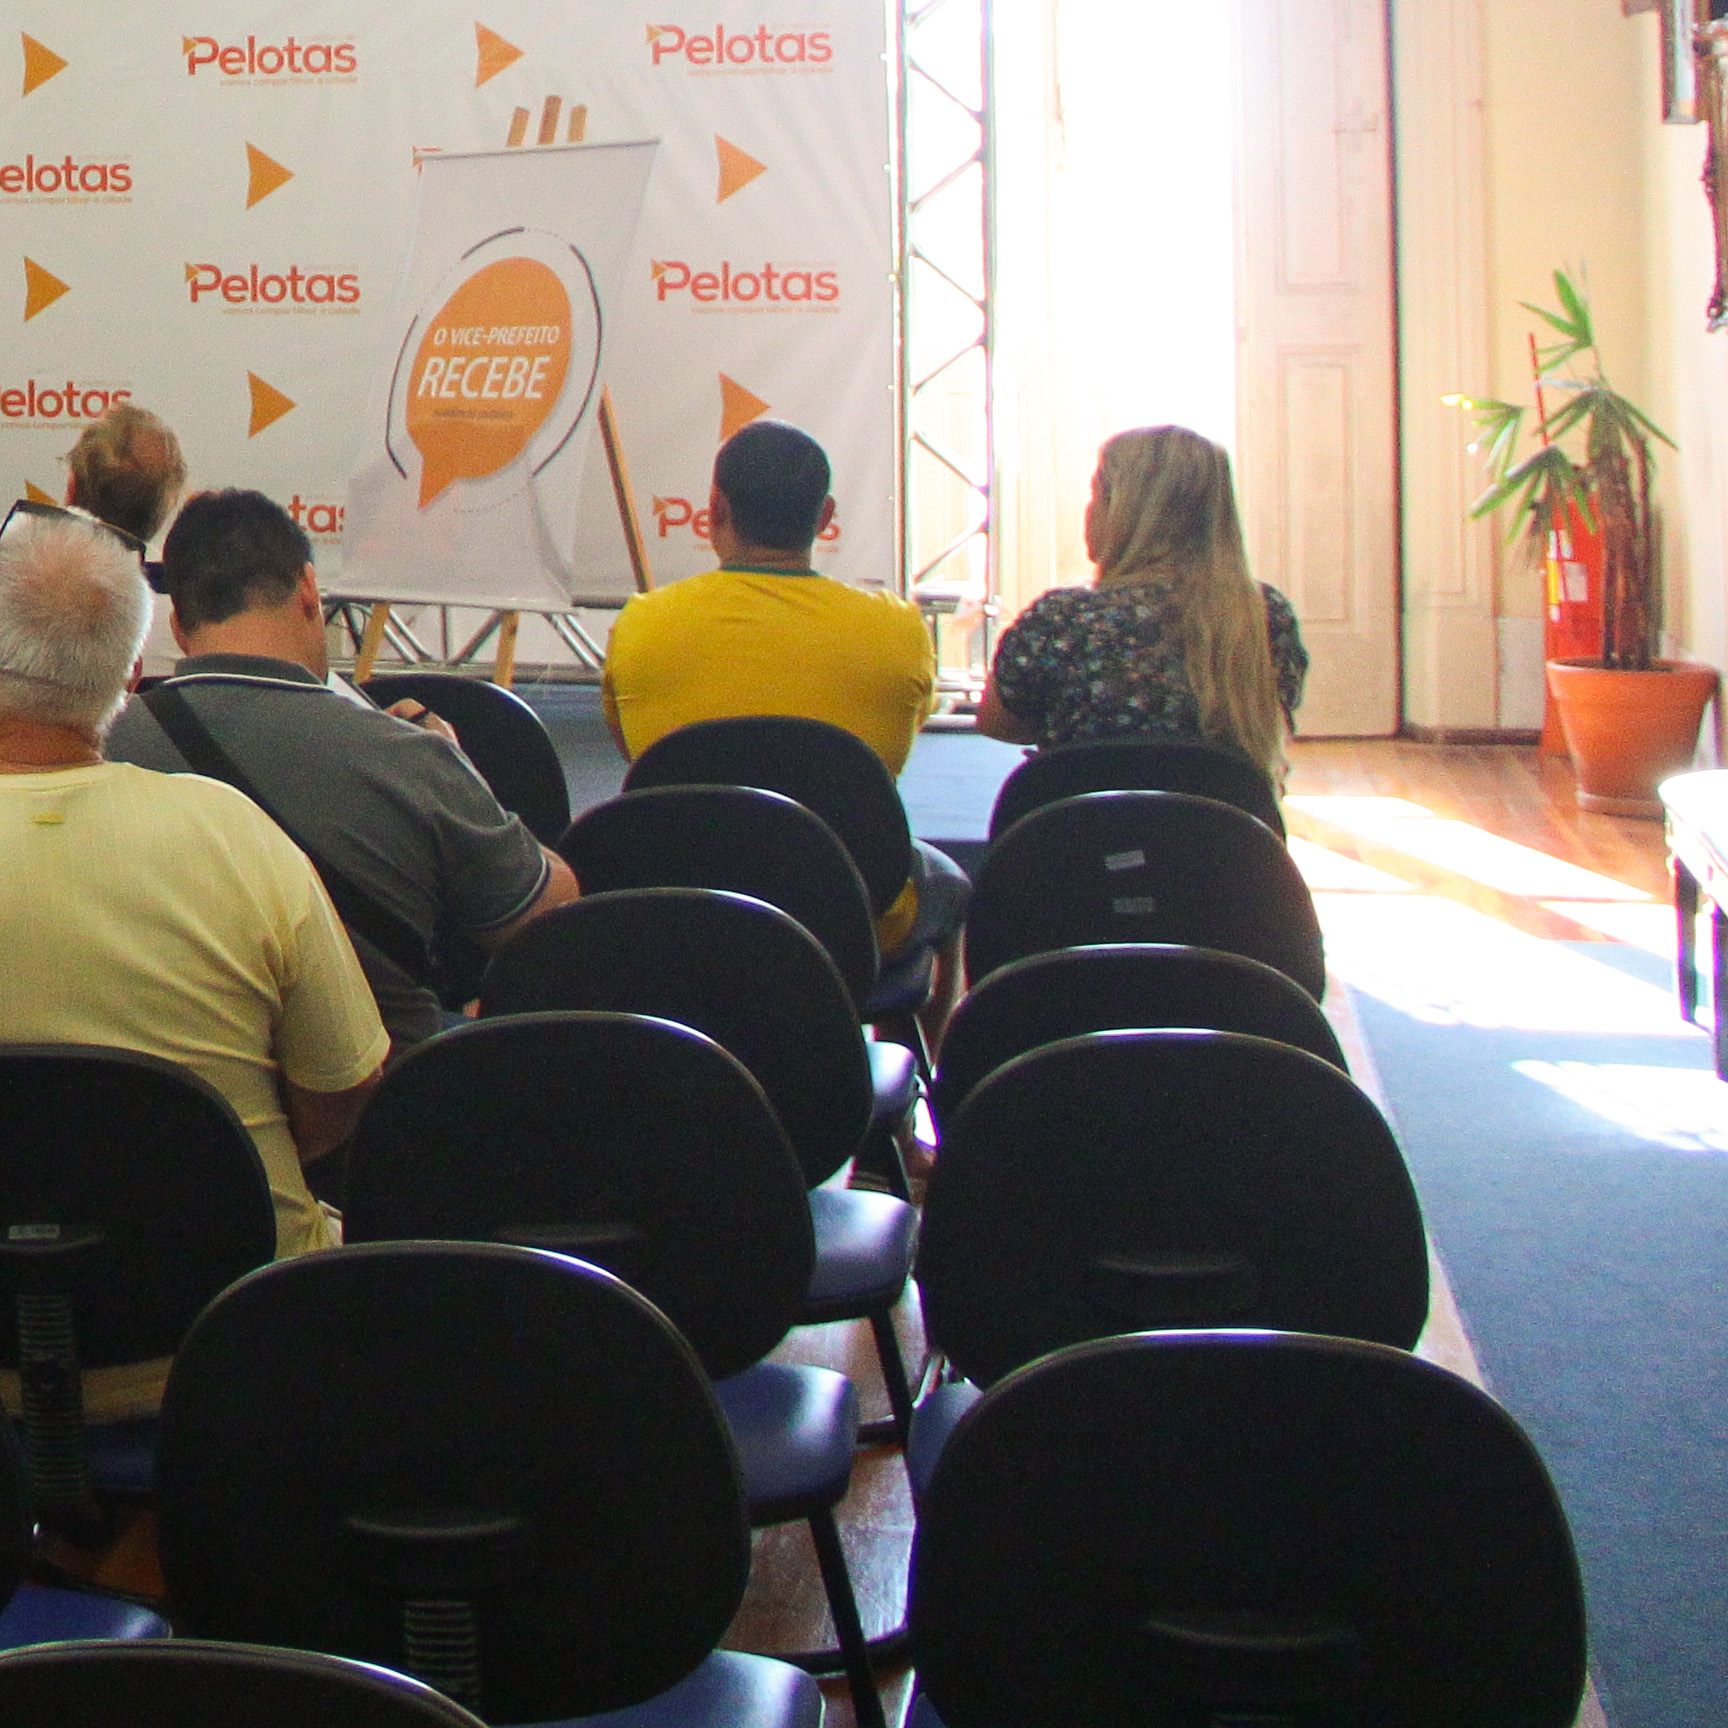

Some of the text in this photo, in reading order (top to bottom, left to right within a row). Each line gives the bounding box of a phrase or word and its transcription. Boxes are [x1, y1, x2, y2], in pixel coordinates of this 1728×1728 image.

[181, 35, 358, 76] Pelotas
[646, 23, 834, 66] Pelotas
[184, 263, 361, 304] Pelotas
[650, 259, 841, 303] Pelotas
[433, 326, 561, 346] O VICE-PREFEITO
[417, 355, 552, 399] RECEBE
